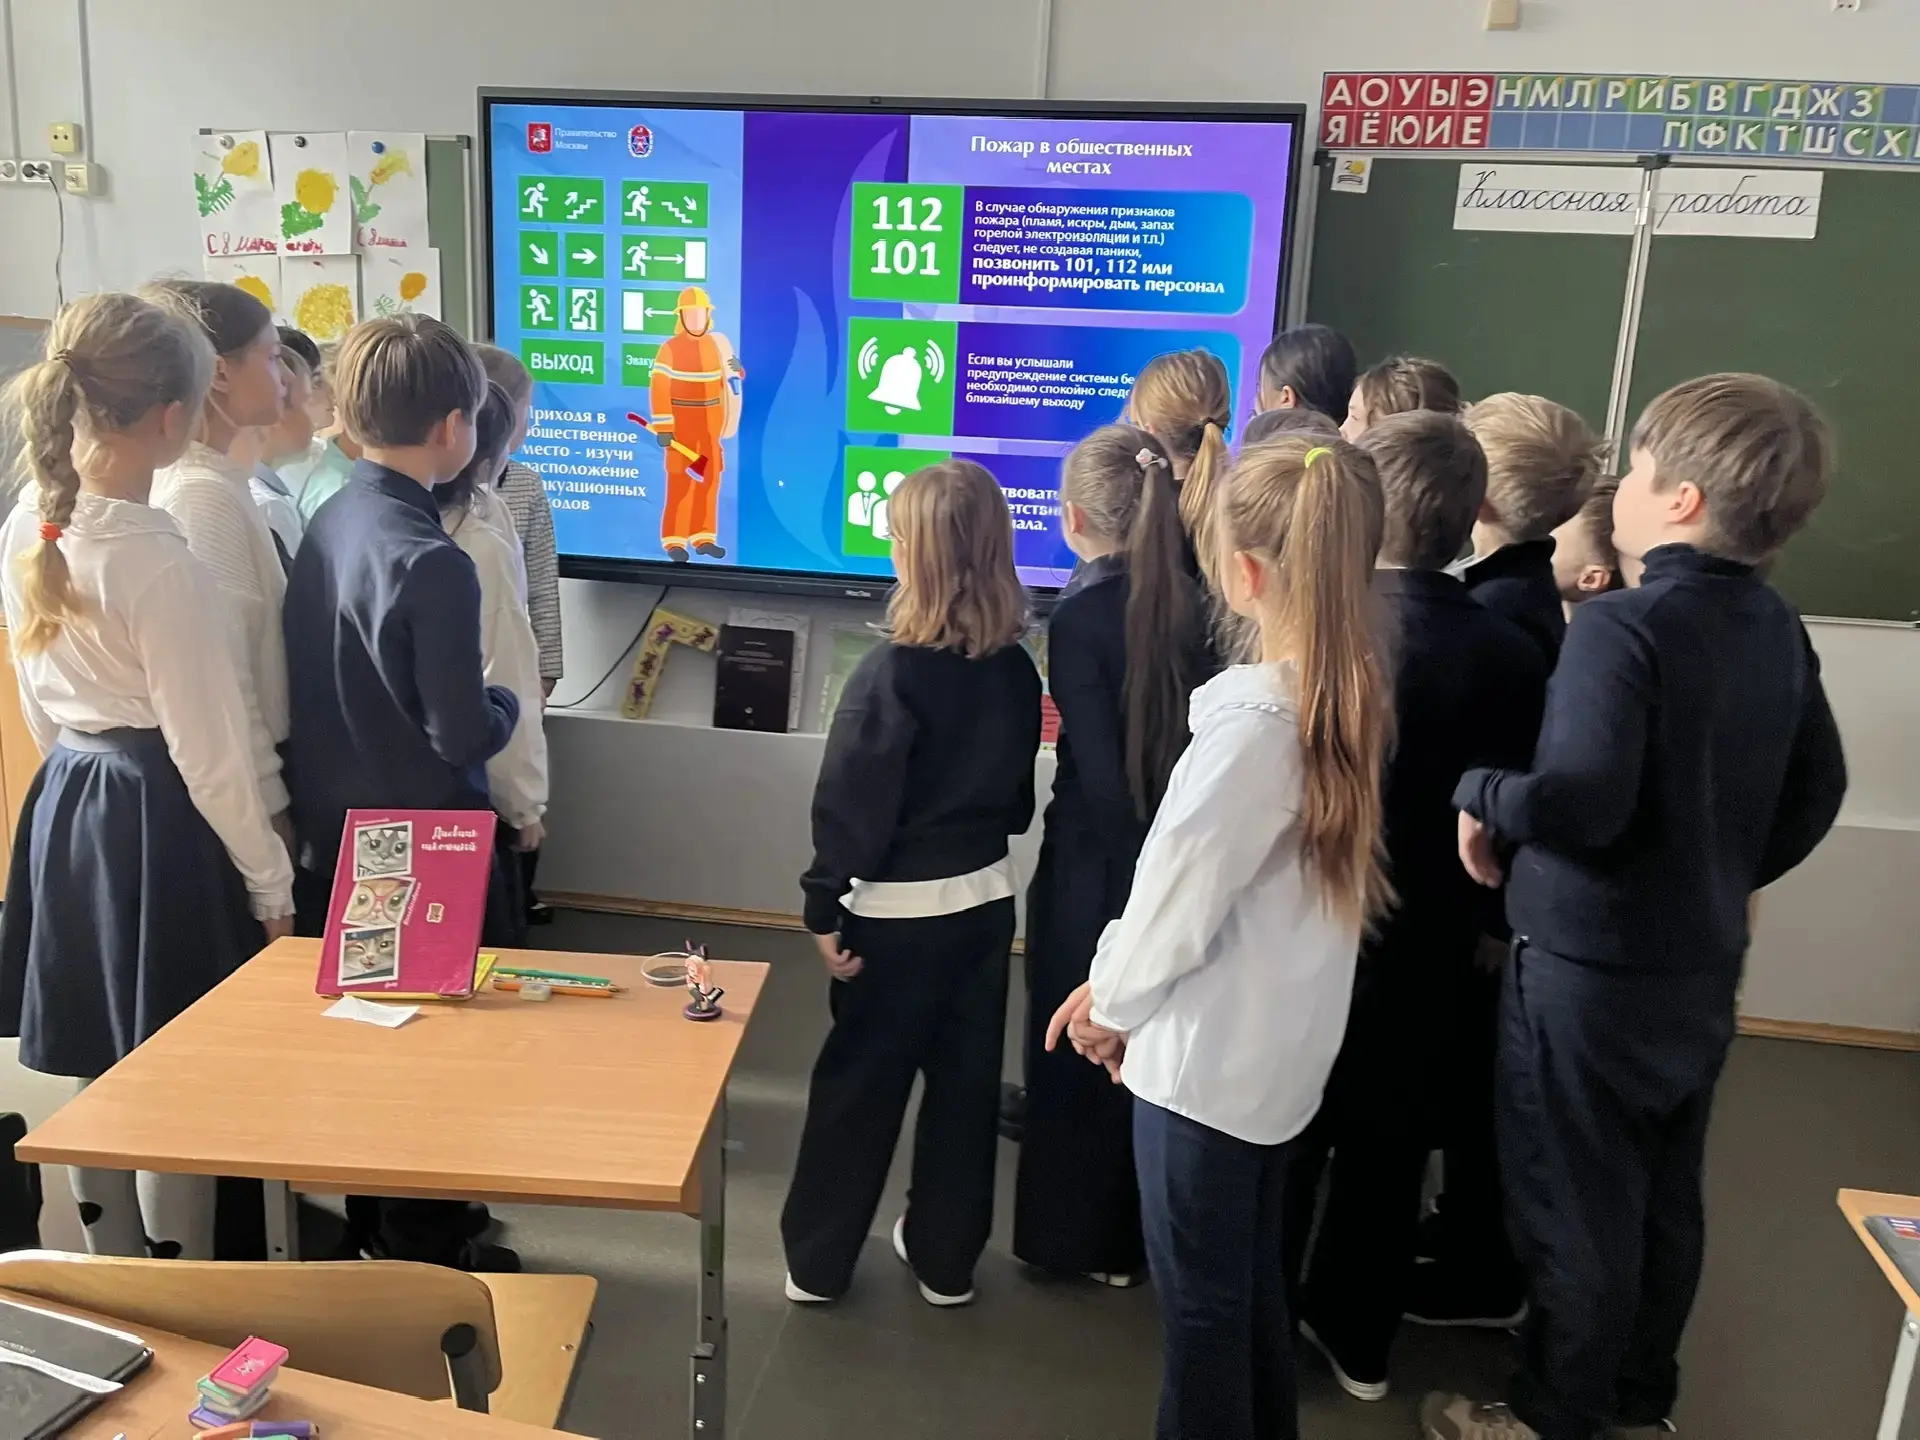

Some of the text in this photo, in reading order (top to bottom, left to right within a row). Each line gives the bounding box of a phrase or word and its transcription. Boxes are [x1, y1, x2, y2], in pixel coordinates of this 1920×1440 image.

[555, 127, 617, 139] Правительство
[971, 136, 1034, 158] Пожар
[1040, 141, 1050, 153] в
[1046, 161, 1112, 175] местах
[975, 200, 1175, 218] В случае обнаружения признаков
[1463, 171, 1811, 229] Классная работа
[872, 196, 943, 232] 112
[975, 215, 1175, 231] пожара (пламя, искры, дым, запах
[974, 227, 1022, 242] горелой
[1025, 231, 1129, 245] электроизоляции
[1132, 234, 1140, 244] и
[870, 238, 940, 276] 101
[973, 243, 1142, 258] следует, не создавая паники,
[973, 257, 1173, 275] позвонить 101, 112 или
[972, 271, 1225, 297] проинформировать персонал
[530, 352, 594, 375] ВЫХОД
[967, 352, 1074, 371] Если вы услышали
[967, 368, 1067, 382] предупреждение
[1069, 374, 1119, 385] системы
[966, 380, 1038, 394] необходимо
[1039, 384, 1096, 397] спокойно
[965, 391, 1086, 410] ближайшему выходу
[597, 412, 607, 424] в
[585, 447, 634, 464] изучи
[547, 499, 590, 511] одов
